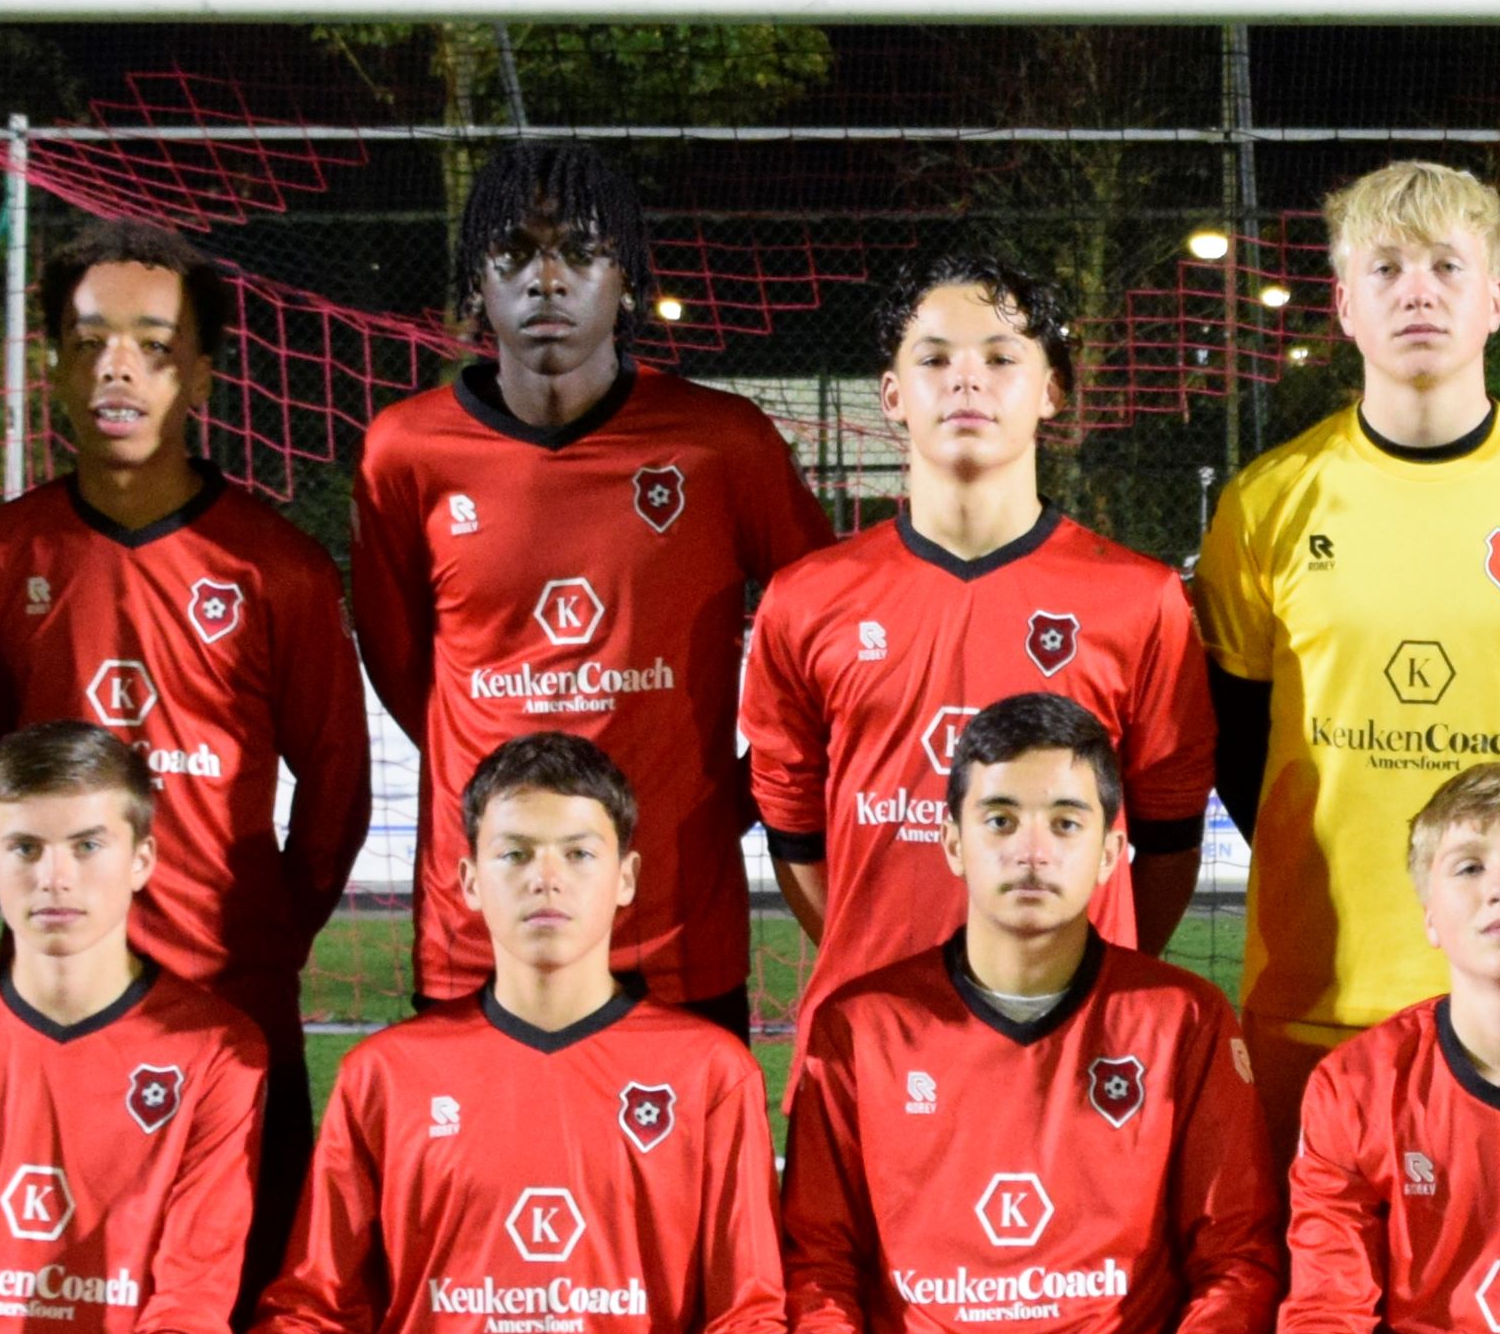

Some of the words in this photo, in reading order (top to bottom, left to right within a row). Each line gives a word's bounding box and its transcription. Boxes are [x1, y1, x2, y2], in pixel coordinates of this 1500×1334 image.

[470, 657, 674, 699] KeukenCoach
[429, 1275, 648, 1320] KeukenCoach
[892, 1257, 1129, 1305] KeukenCoach
